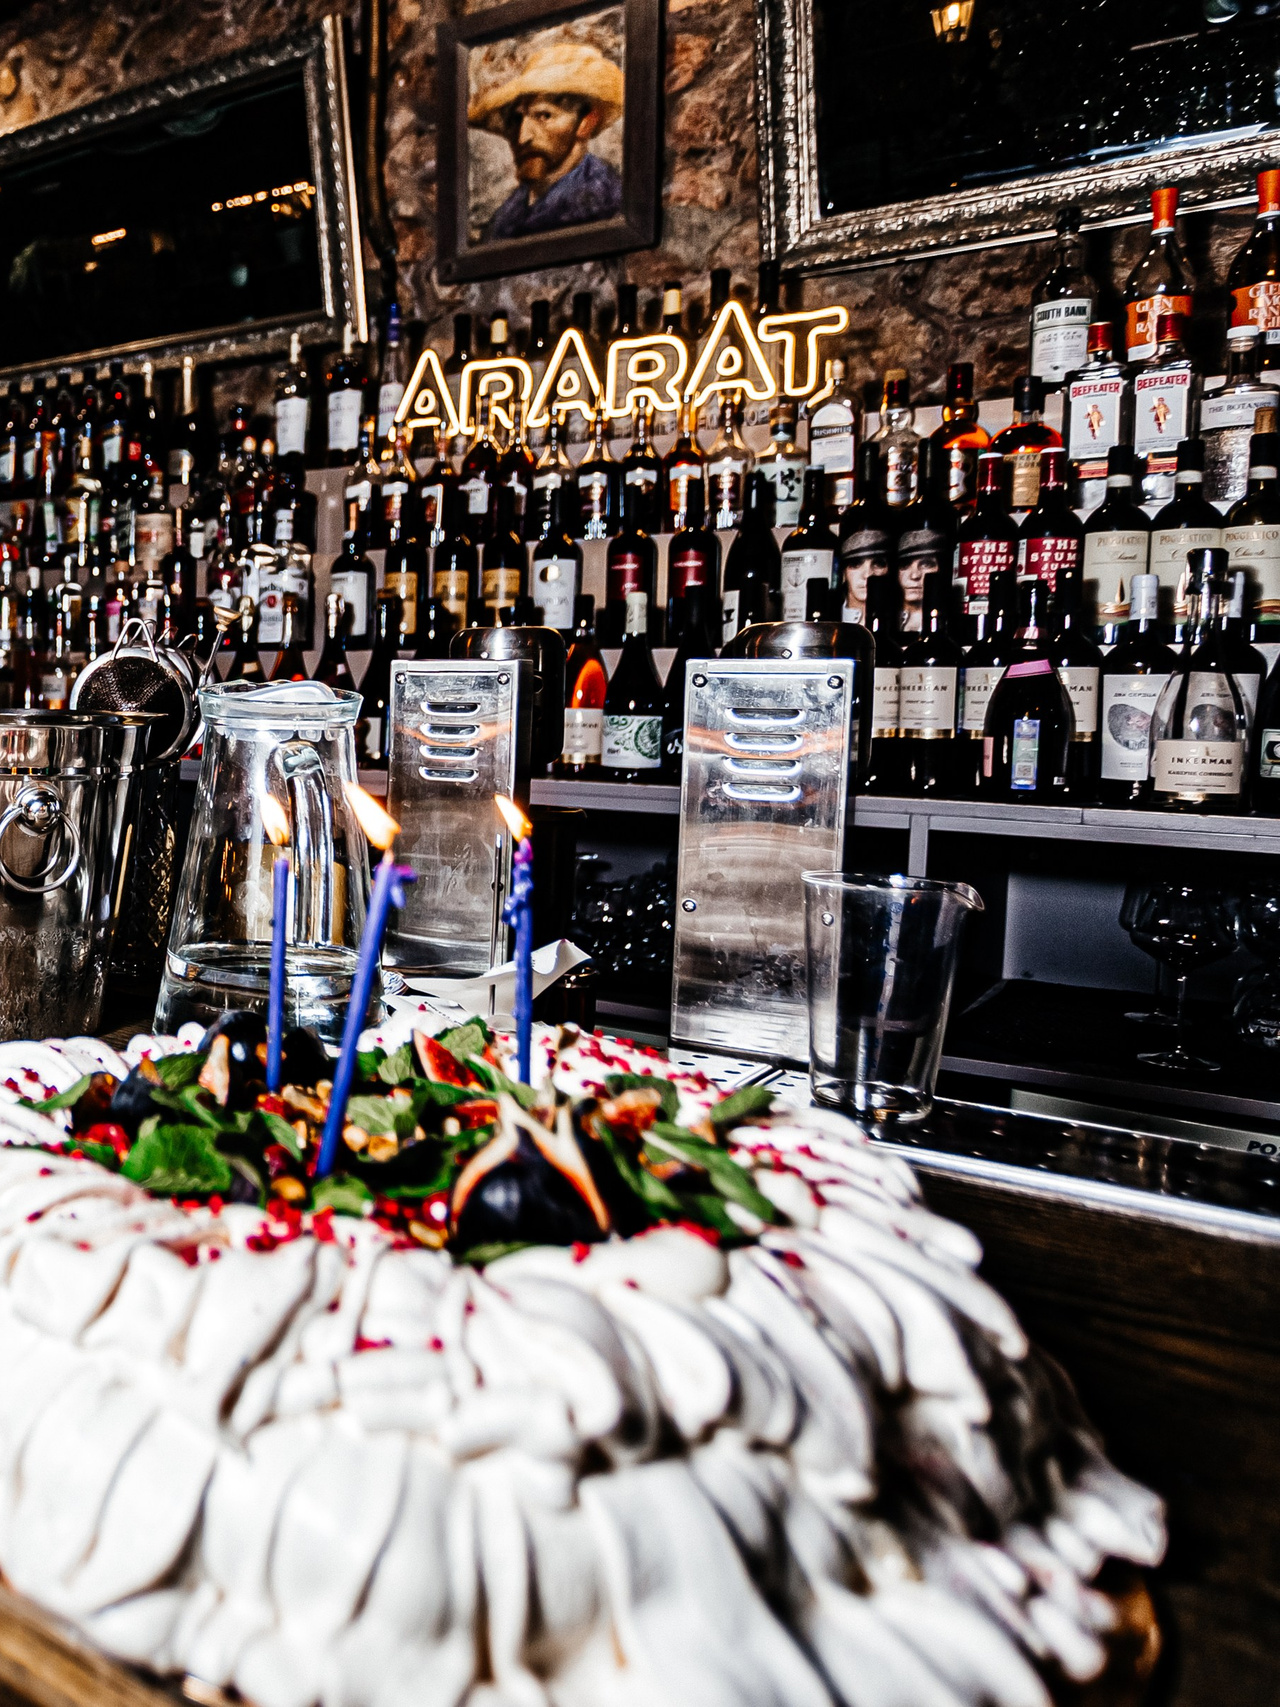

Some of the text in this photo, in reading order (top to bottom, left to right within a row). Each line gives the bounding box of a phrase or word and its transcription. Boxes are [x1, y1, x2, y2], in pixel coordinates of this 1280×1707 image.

[1135, 297, 1174, 313] GLEN
[1037, 305, 1088, 322] SOUTH BANK
[392, 300, 849, 438] ARARAT
[1136, 374, 1188, 391] BEEFEATER
[1071, 382, 1120, 398] BEEFEATER
[1208, 405, 1224, 414] THE
[971, 541, 1008, 554] THE
[1042, 539, 1078, 551] THE
[961, 554, 1014, 566] STUMP
[1030, 552, 1077, 562] STUM
[1171, 757, 1233, 765] INKERMAN
[1246, 1140, 1280, 1156] PO
